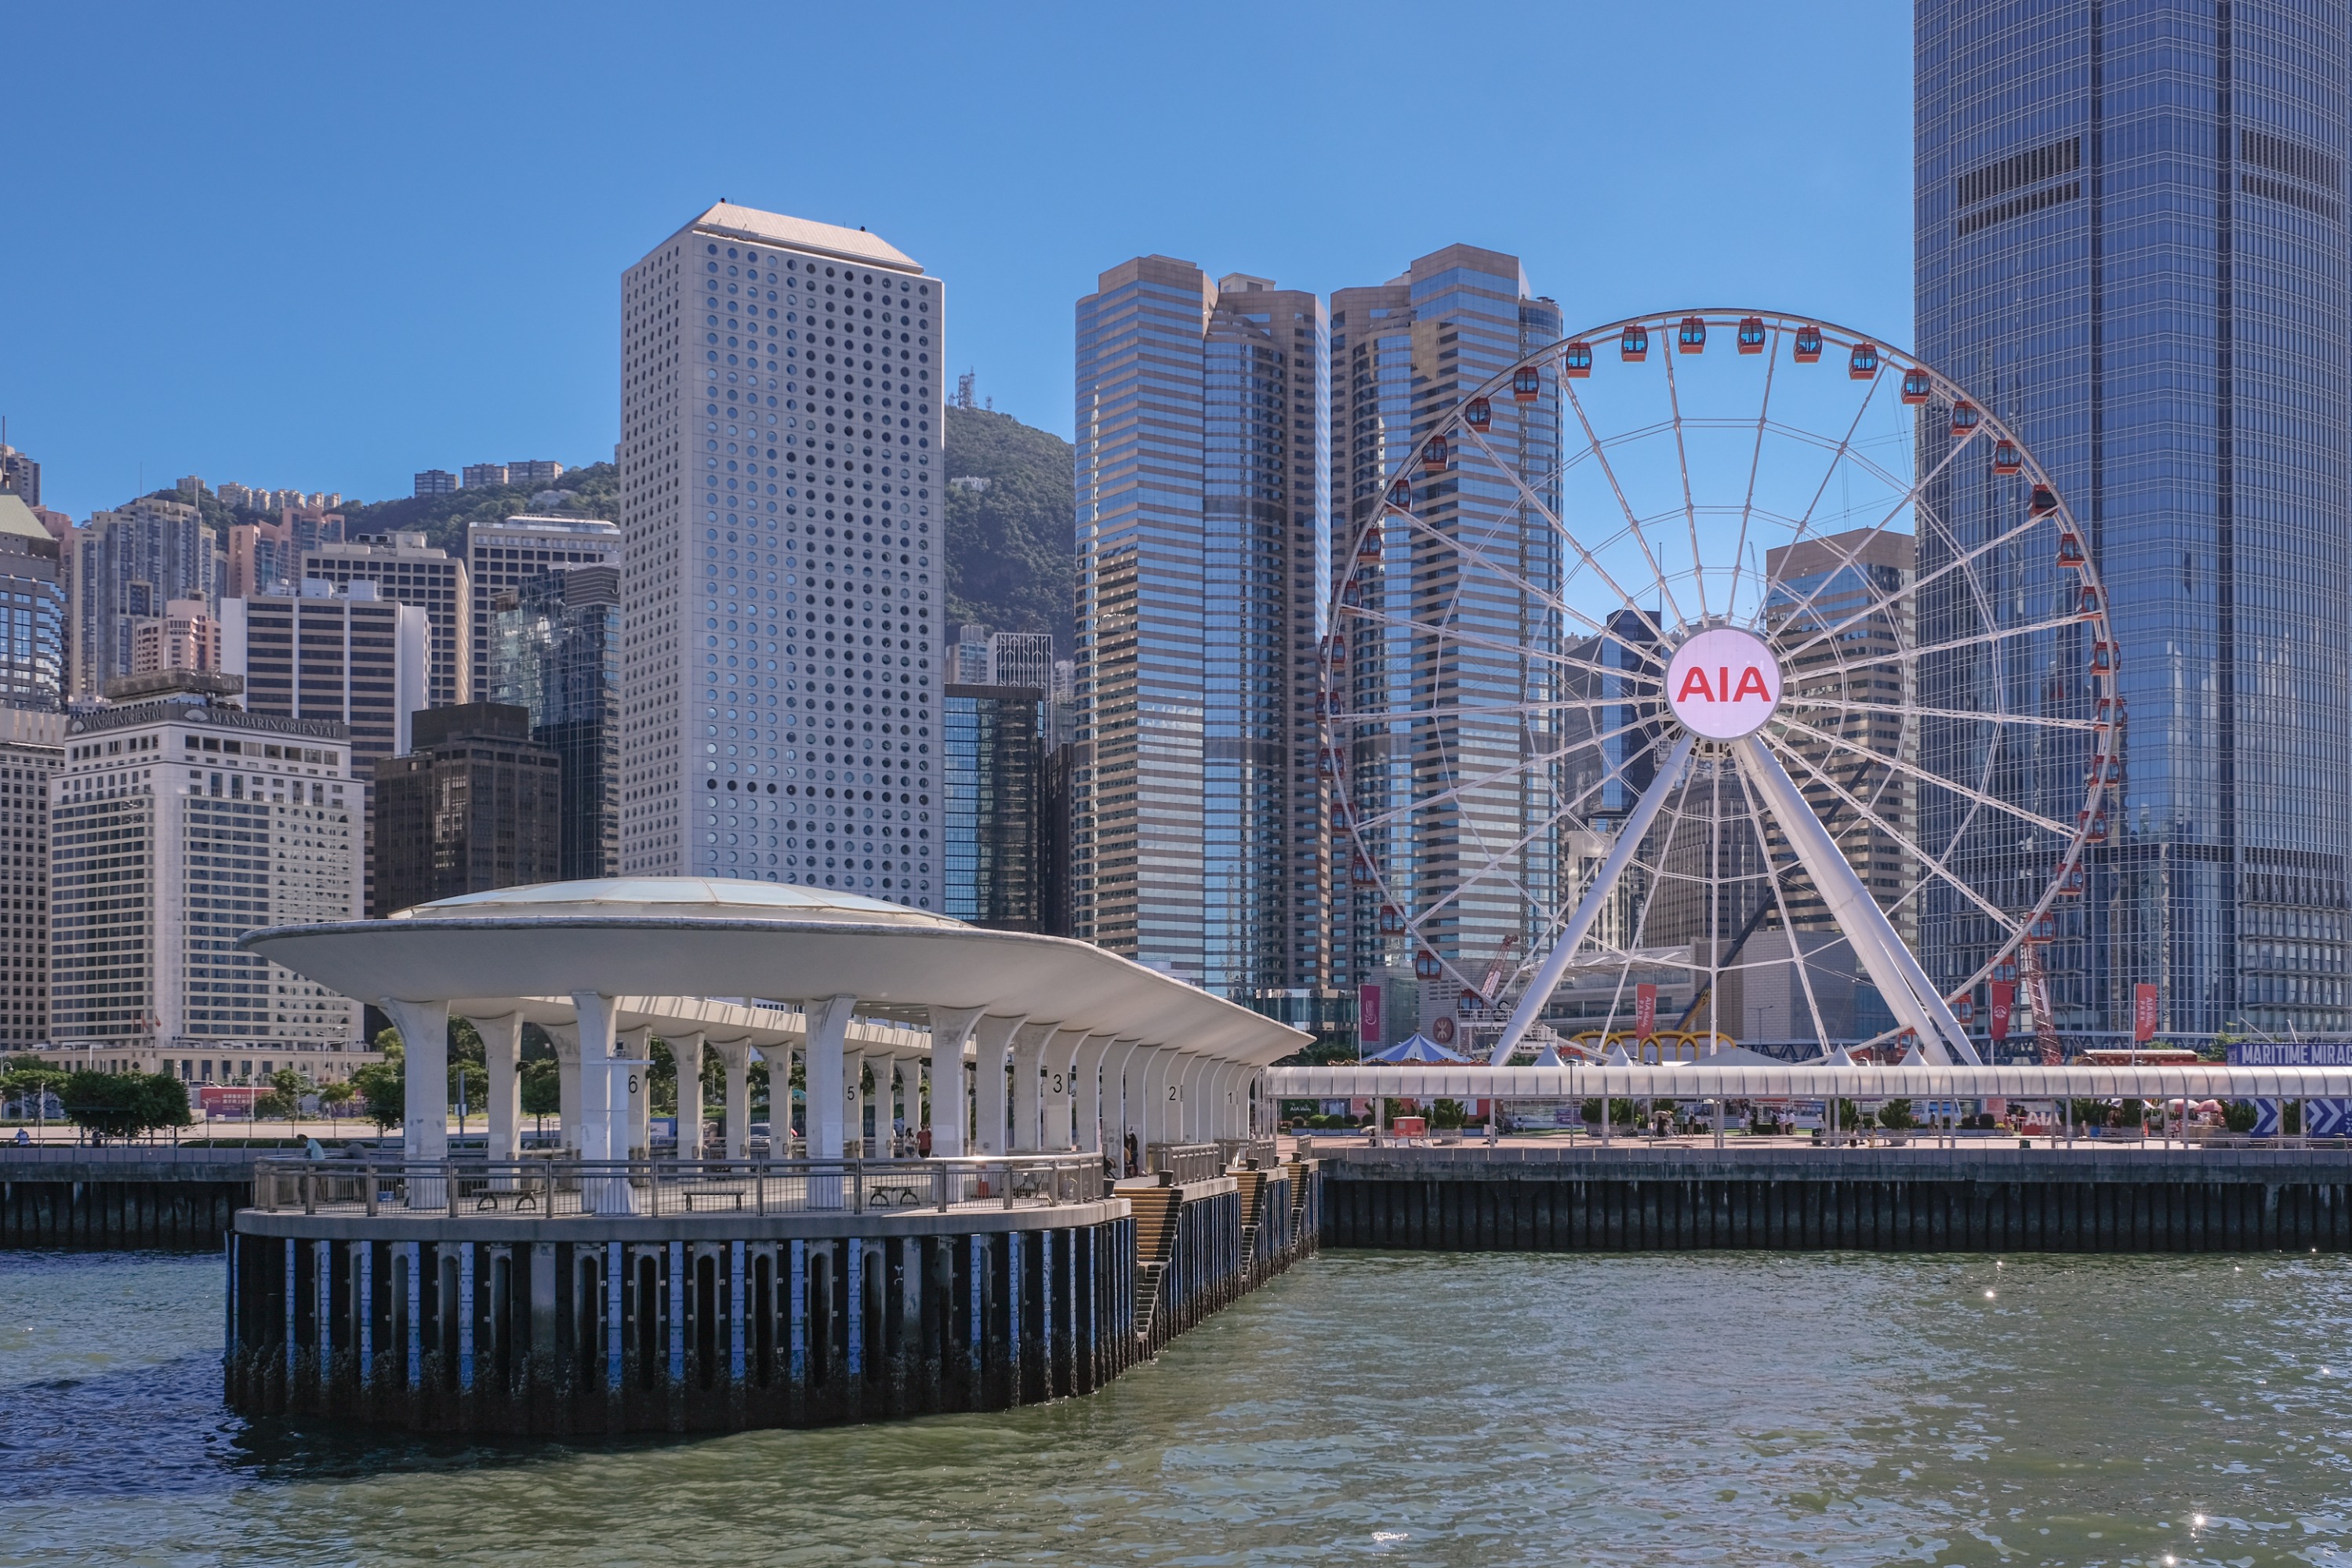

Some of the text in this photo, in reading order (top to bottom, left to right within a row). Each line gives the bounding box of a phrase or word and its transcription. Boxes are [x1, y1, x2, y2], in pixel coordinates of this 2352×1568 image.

[1676, 666, 1772, 702] AIA
[85, 709, 161, 730] MANDARIN ORIENTAL
[212, 712, 337, 738] MANDARIN ORIENTAL
[2241, 1044, 2308, 1064] MARITIME
[629, 1074, 637, 1094] 6
[1053, 1074, 1062, 1093] 3
[848, 1086, 855, 1101] 5
[1169, 1086, 1176, 1101] 2
[1228, 1091, 1232, 1104] 1
[2025, 1112, 2062, 1126] AIA
